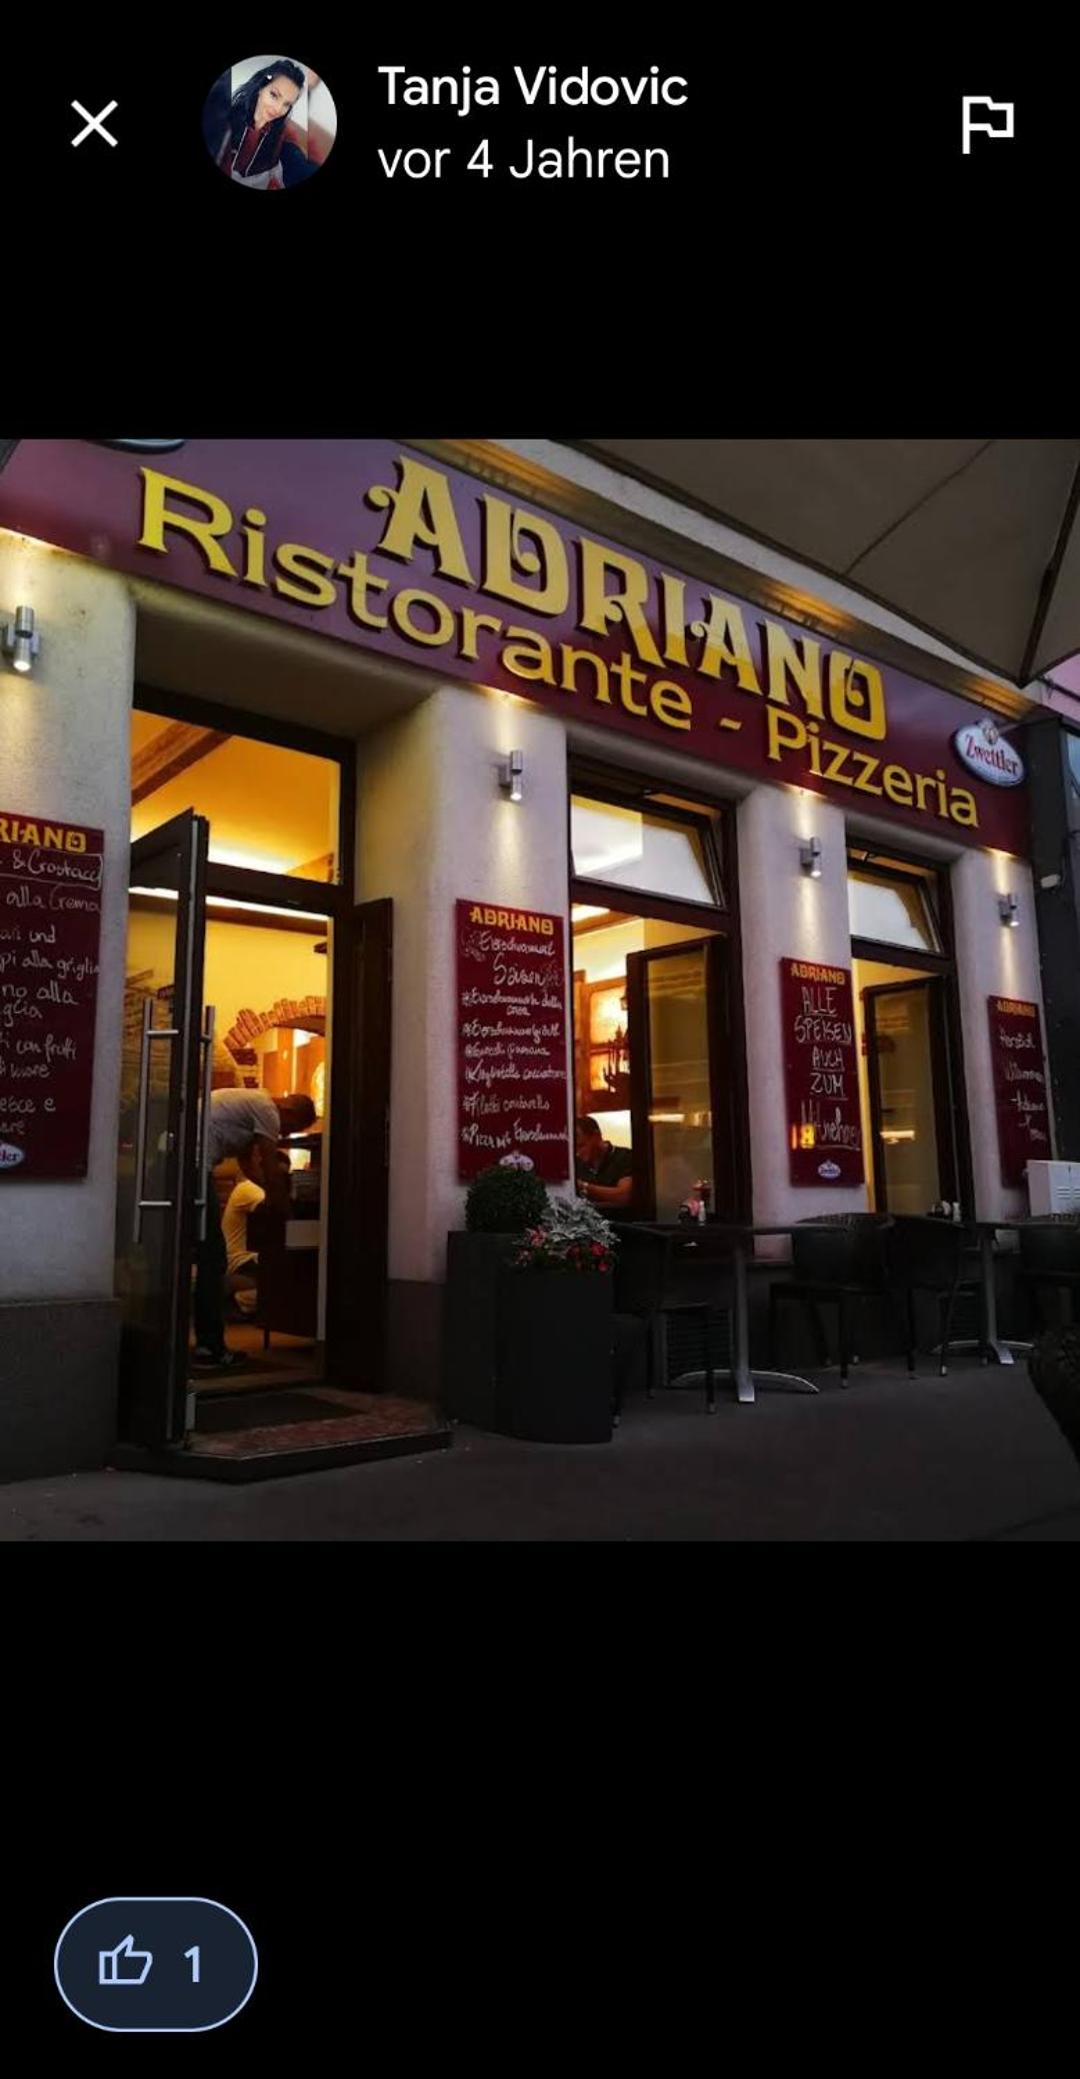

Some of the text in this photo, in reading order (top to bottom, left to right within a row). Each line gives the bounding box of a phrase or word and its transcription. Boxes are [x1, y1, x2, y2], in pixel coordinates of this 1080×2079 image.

[364, 456, 887, 741] ADRIANO
[138, 466, 692, 731] Ristorante
[766, 703, 980, 828] Pizzeria
[965, 733, 1018, 776] Zwettler
[6, 885, 47, 909] alla
[29, 923, 56, 944] und
[469, 906, 554, 936] ADRIANO
[22, 950, 53, 970] alla
[790, 962, 846, 986] ADRIANO
[36, 980, 79, 1006] alla
[801, 986, 837, 1016] ALLE
[811, 1045, 844, 1068] AUCH
[810, 1072, 844, 1097] ZUM
[44, 1098, 56, 1112] e
